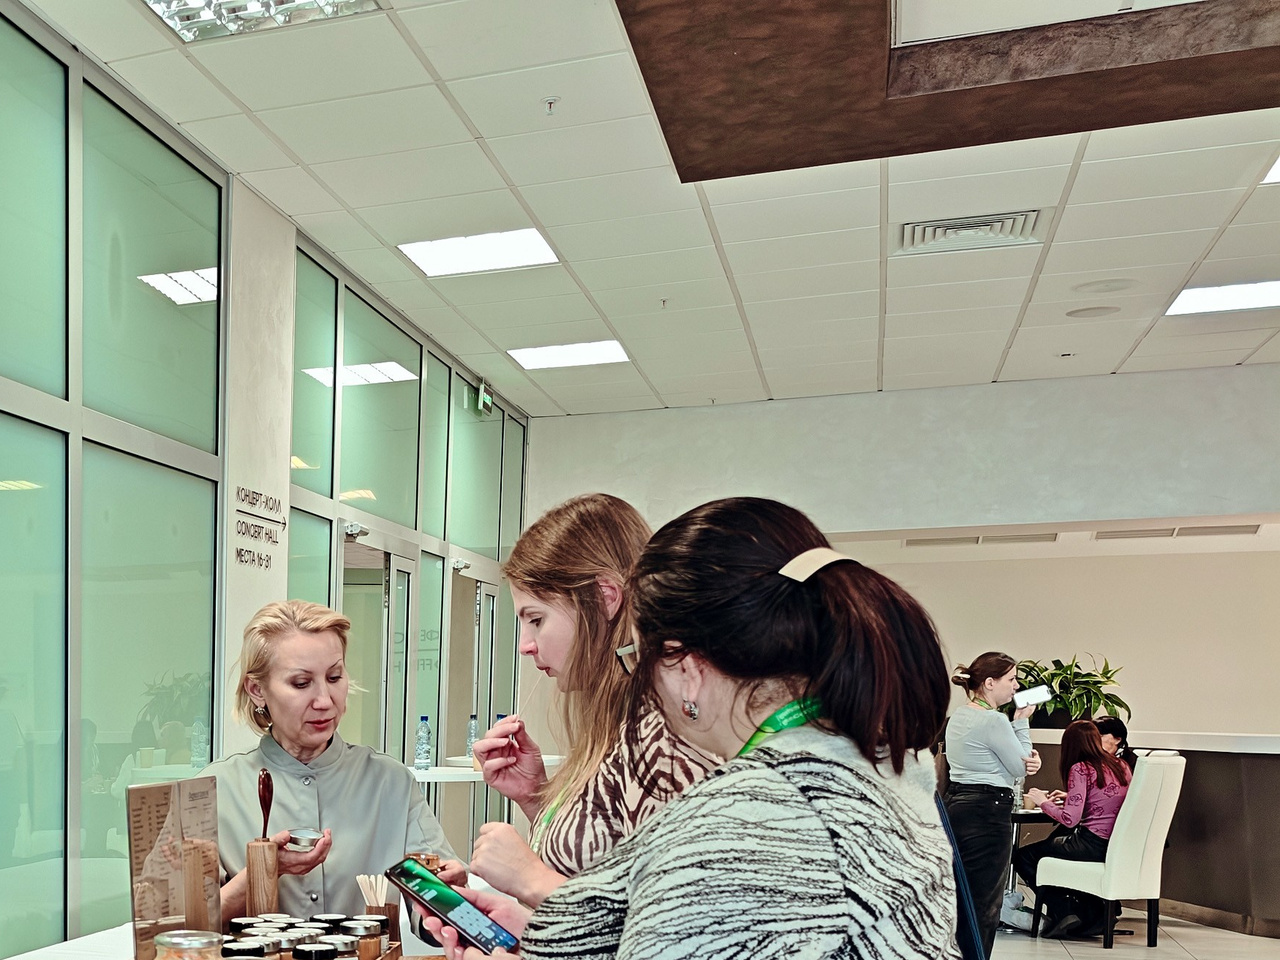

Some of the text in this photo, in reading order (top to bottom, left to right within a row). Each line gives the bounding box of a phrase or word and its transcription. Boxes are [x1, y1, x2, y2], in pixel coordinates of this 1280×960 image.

[236, 486, 281, 514] КОНЦЕРТ-ХОЛЛ
[236, 520, 278, 544] CONCERT HALL
[236, 547, 256, 565] МЕСТА
